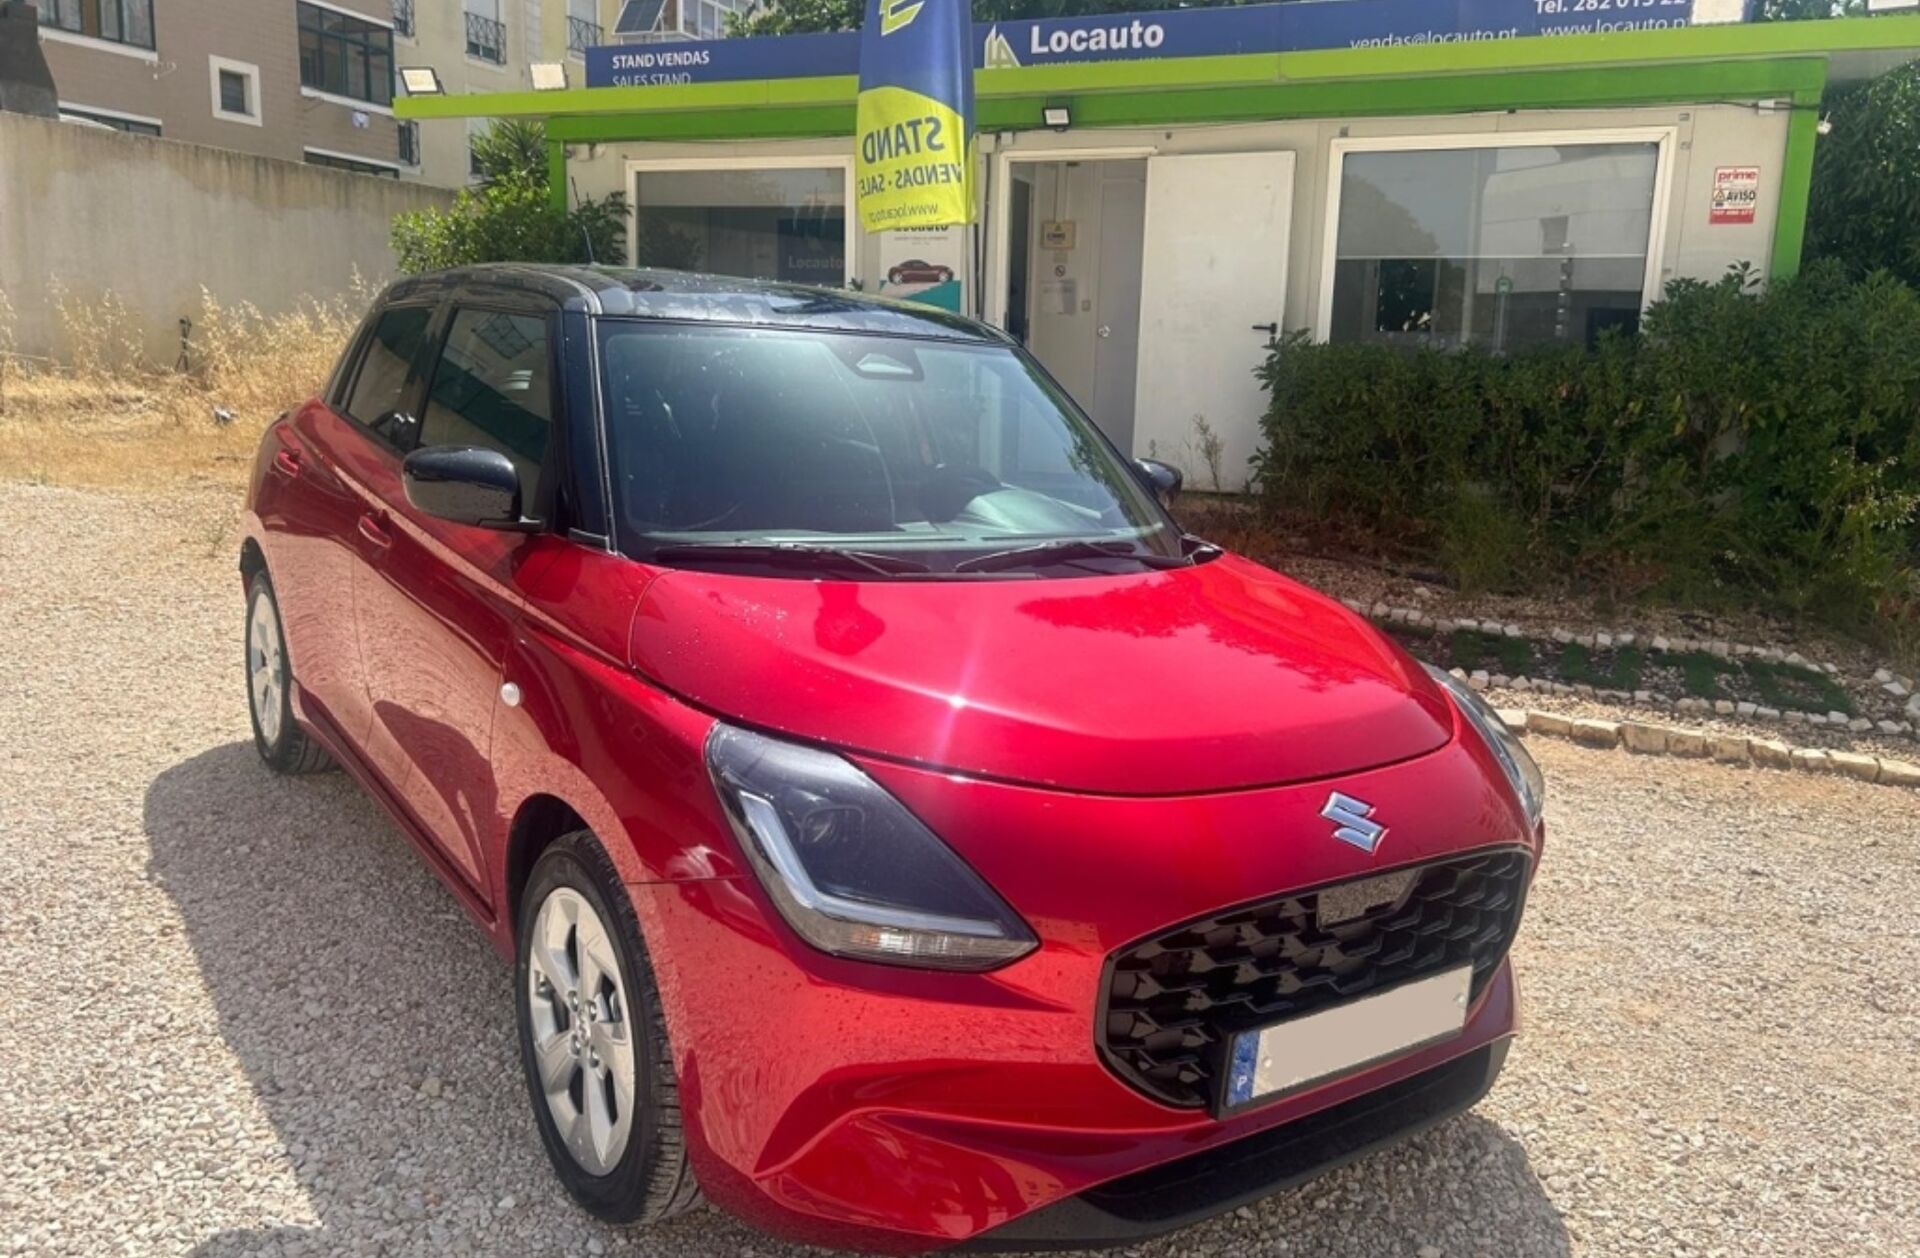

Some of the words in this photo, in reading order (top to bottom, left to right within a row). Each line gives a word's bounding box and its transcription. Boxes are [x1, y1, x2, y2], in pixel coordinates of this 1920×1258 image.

[1535, 0, 1568, 15] Tel.
[1031, 20, 1164, 54] Locauto
[1350, 27, 1518, 49] vendas@locautopt
[612, 53, 654, 69] STAND
[657, 50, 710, 66] VENDAS
[650, 72, 691, 87] STAND
[1726, 190, 1756, 202] AVISO
[1235, 1074, 1249, 1091] P
